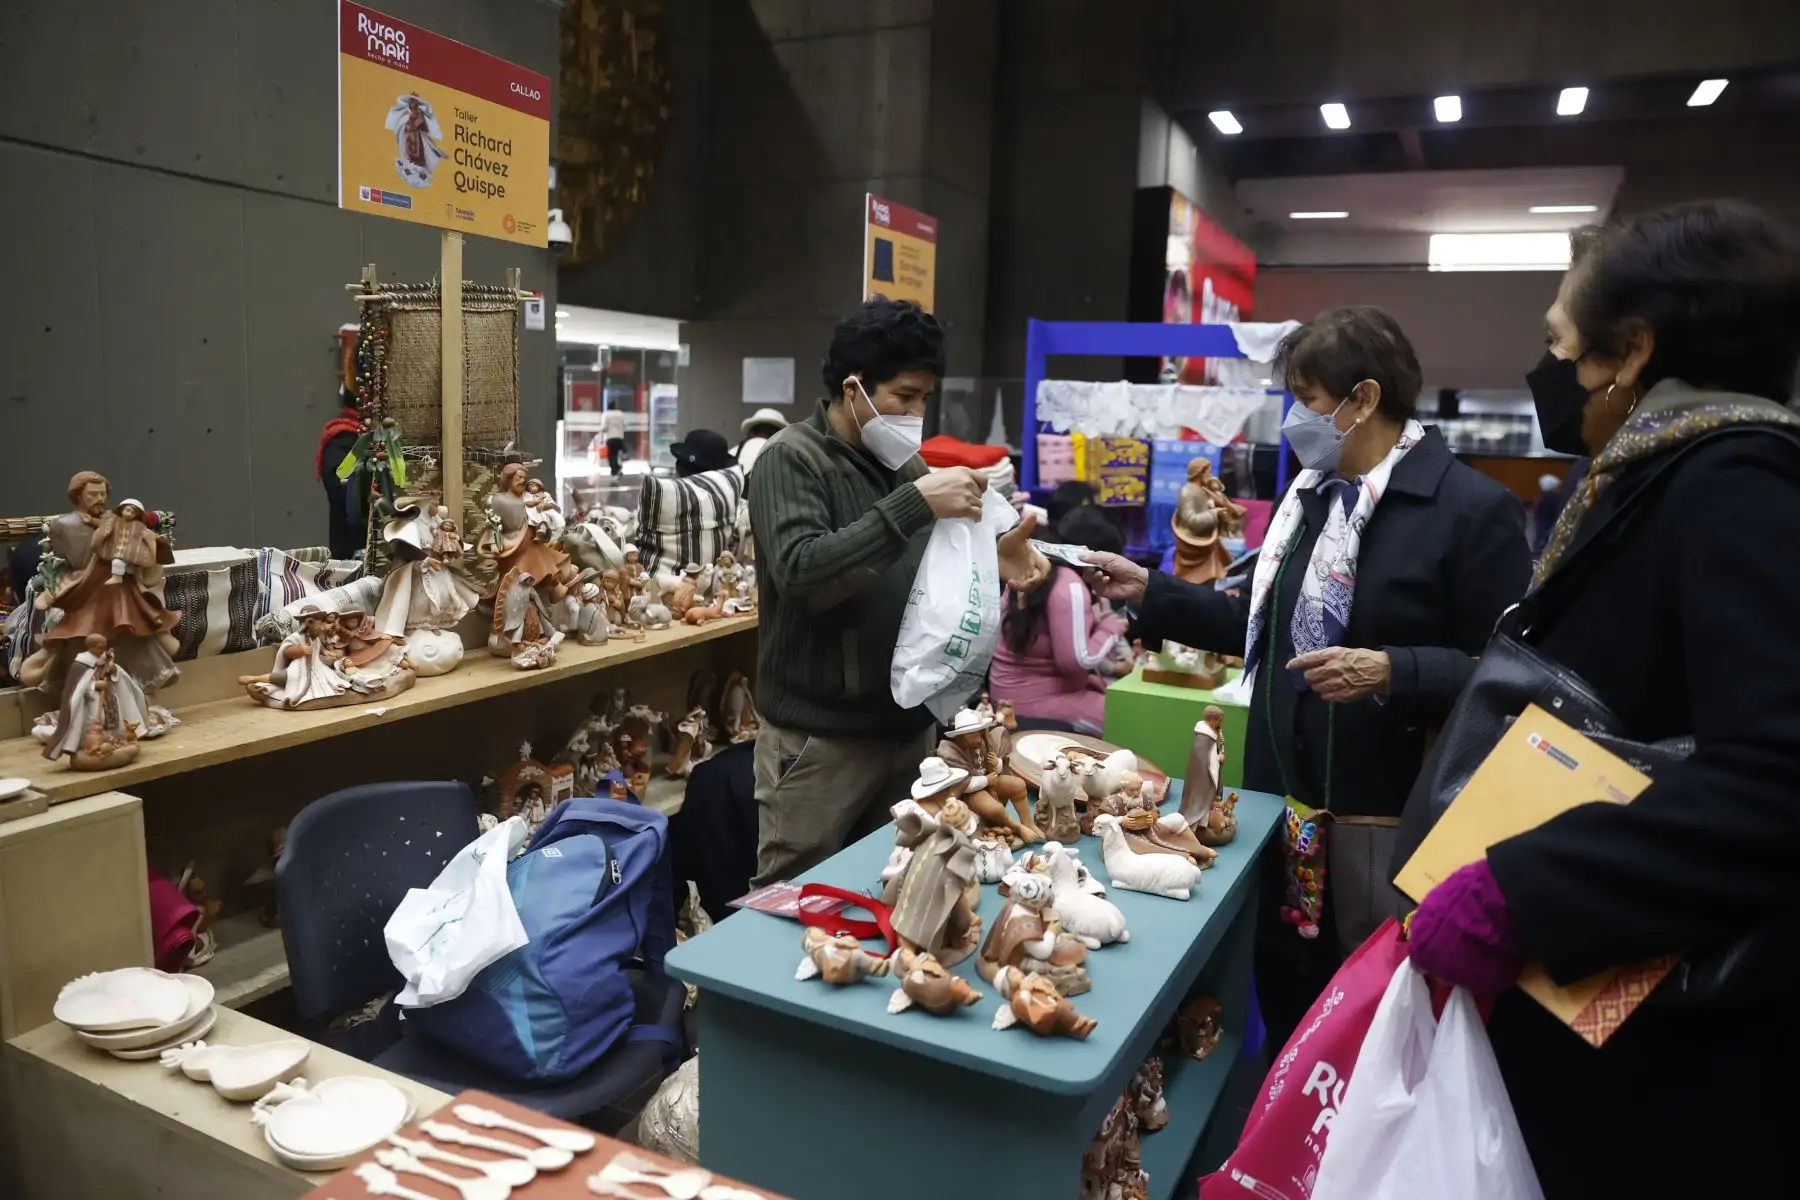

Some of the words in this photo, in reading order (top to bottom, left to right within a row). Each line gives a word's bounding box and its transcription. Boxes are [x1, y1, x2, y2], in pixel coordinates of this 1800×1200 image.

[510, 82, 541, 101] CALLAO
[454, 107, 478, 123] Taller
[454, 123, 512, 157] Richard
[453, 147, 509, 178] Chávez
[453, 170, 506, 199] Quispe
